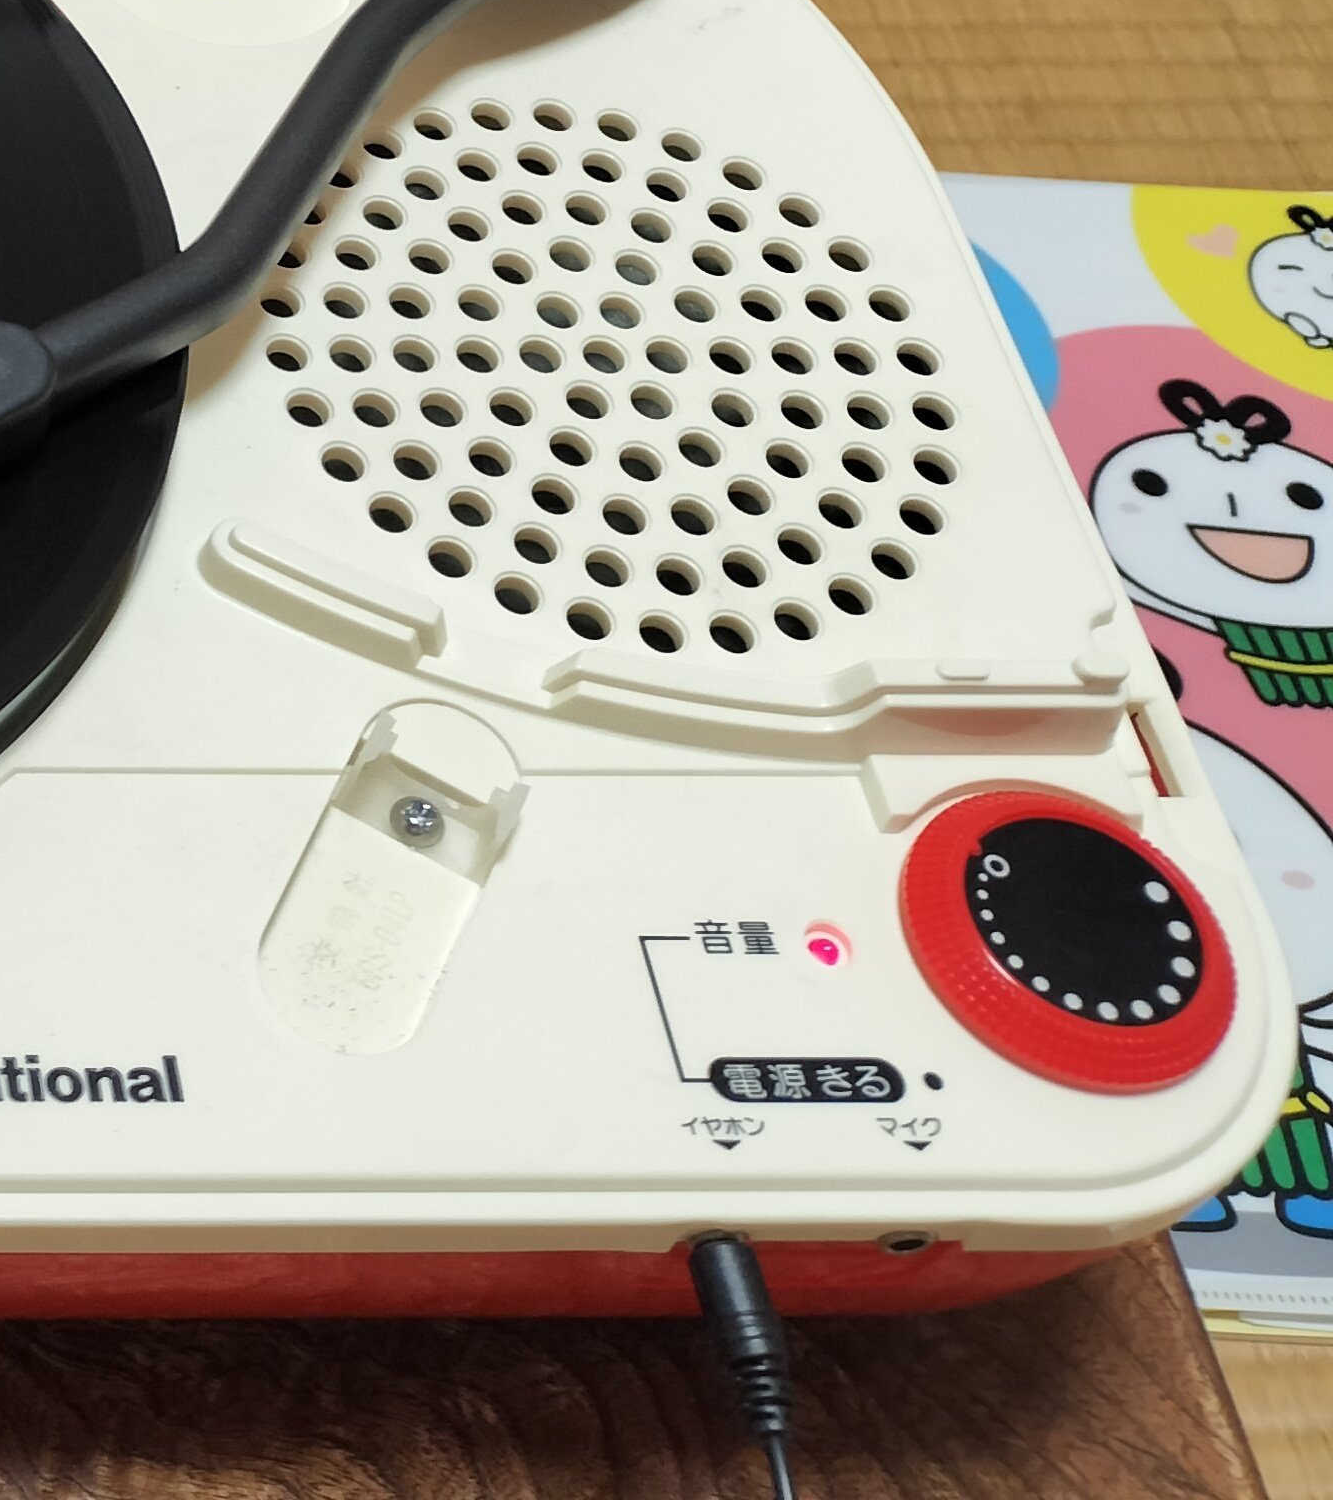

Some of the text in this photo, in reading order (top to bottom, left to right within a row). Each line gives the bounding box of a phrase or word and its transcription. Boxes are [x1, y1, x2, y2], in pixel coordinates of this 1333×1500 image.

[693, 919, 780, 955] 音量
[680, 1116, 766, 1137] イヤホン
[875, 1116, 943, 1137] マイク
